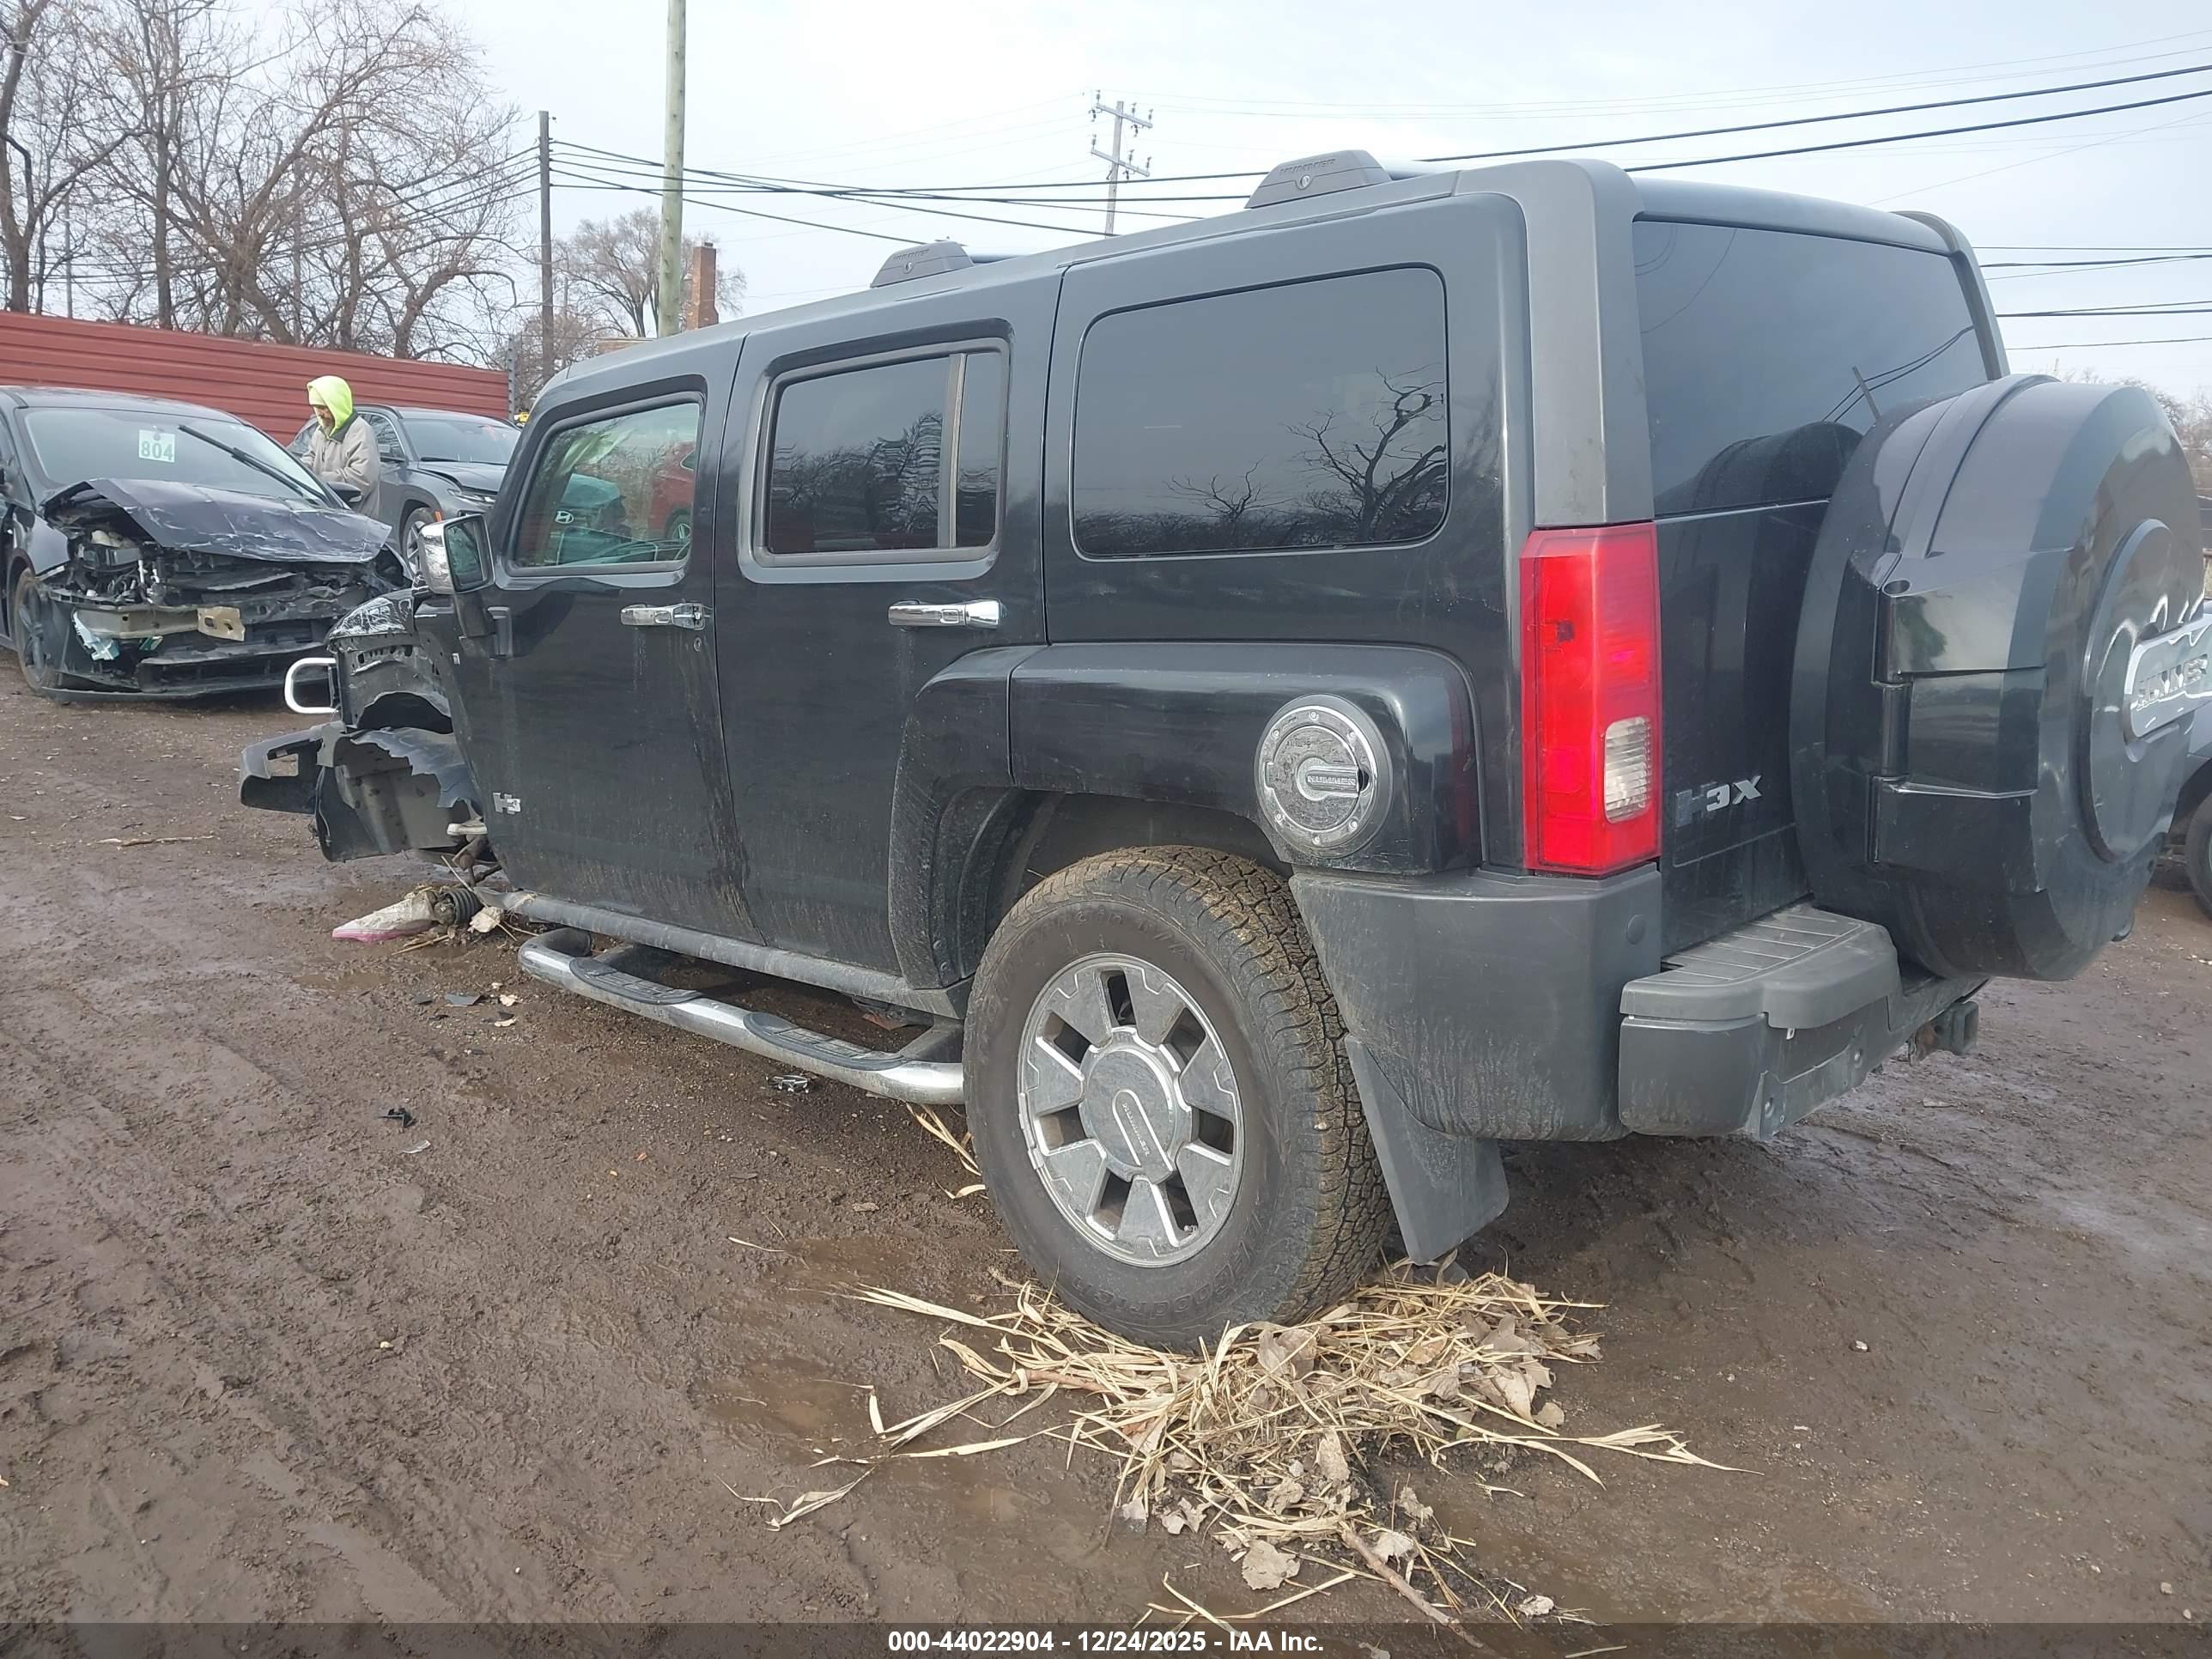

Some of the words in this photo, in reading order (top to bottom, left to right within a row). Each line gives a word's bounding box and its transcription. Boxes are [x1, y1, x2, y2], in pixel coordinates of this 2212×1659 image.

[1279, 158, 1336, 175] HUMMER
[141, 440, 173, 461] 804
[1307, 775, 1356, 786] HUMMER
[492, 792, 521, 815] H3
[1675, 775, 1763, 827] H3X
